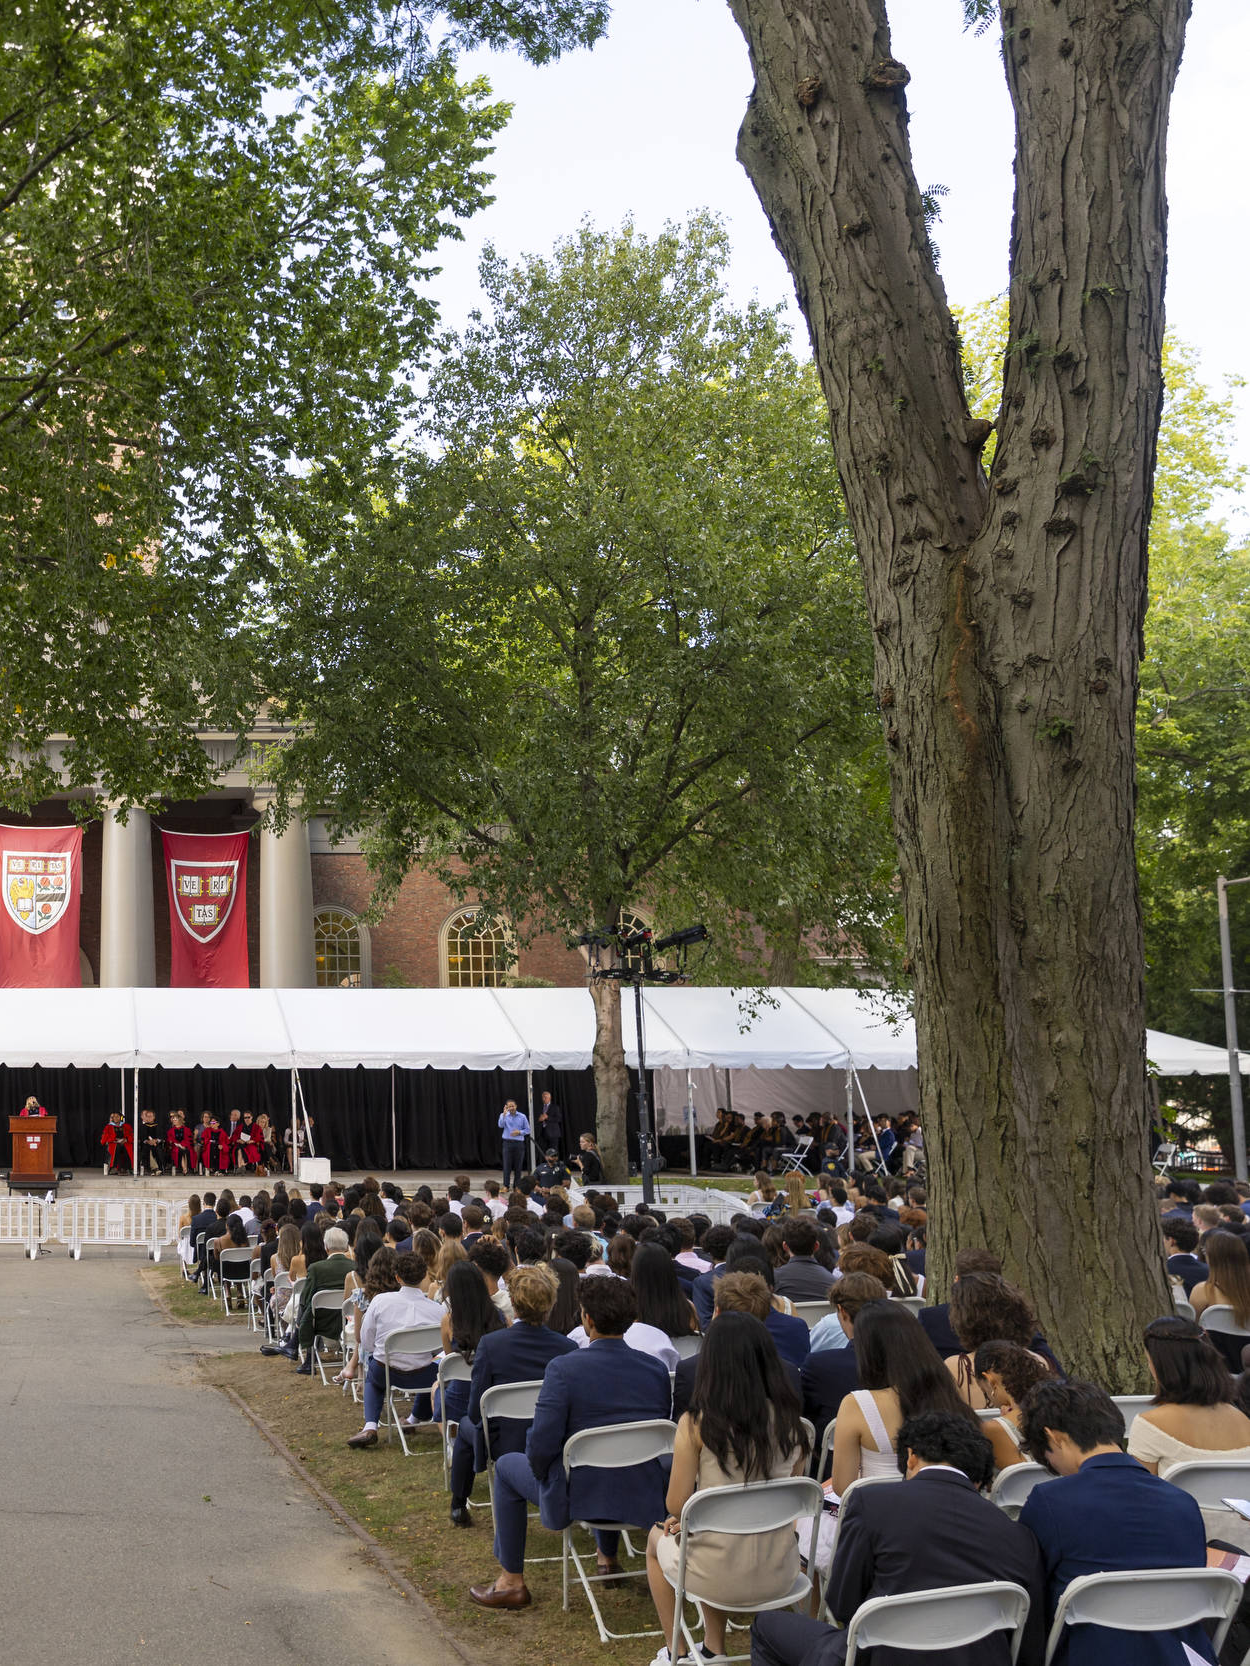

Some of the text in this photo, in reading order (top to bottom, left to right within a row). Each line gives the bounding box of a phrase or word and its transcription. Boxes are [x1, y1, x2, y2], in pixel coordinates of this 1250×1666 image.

[184, 880, 224, 889] VE RI
[197, 909, 213, 918] TAS
